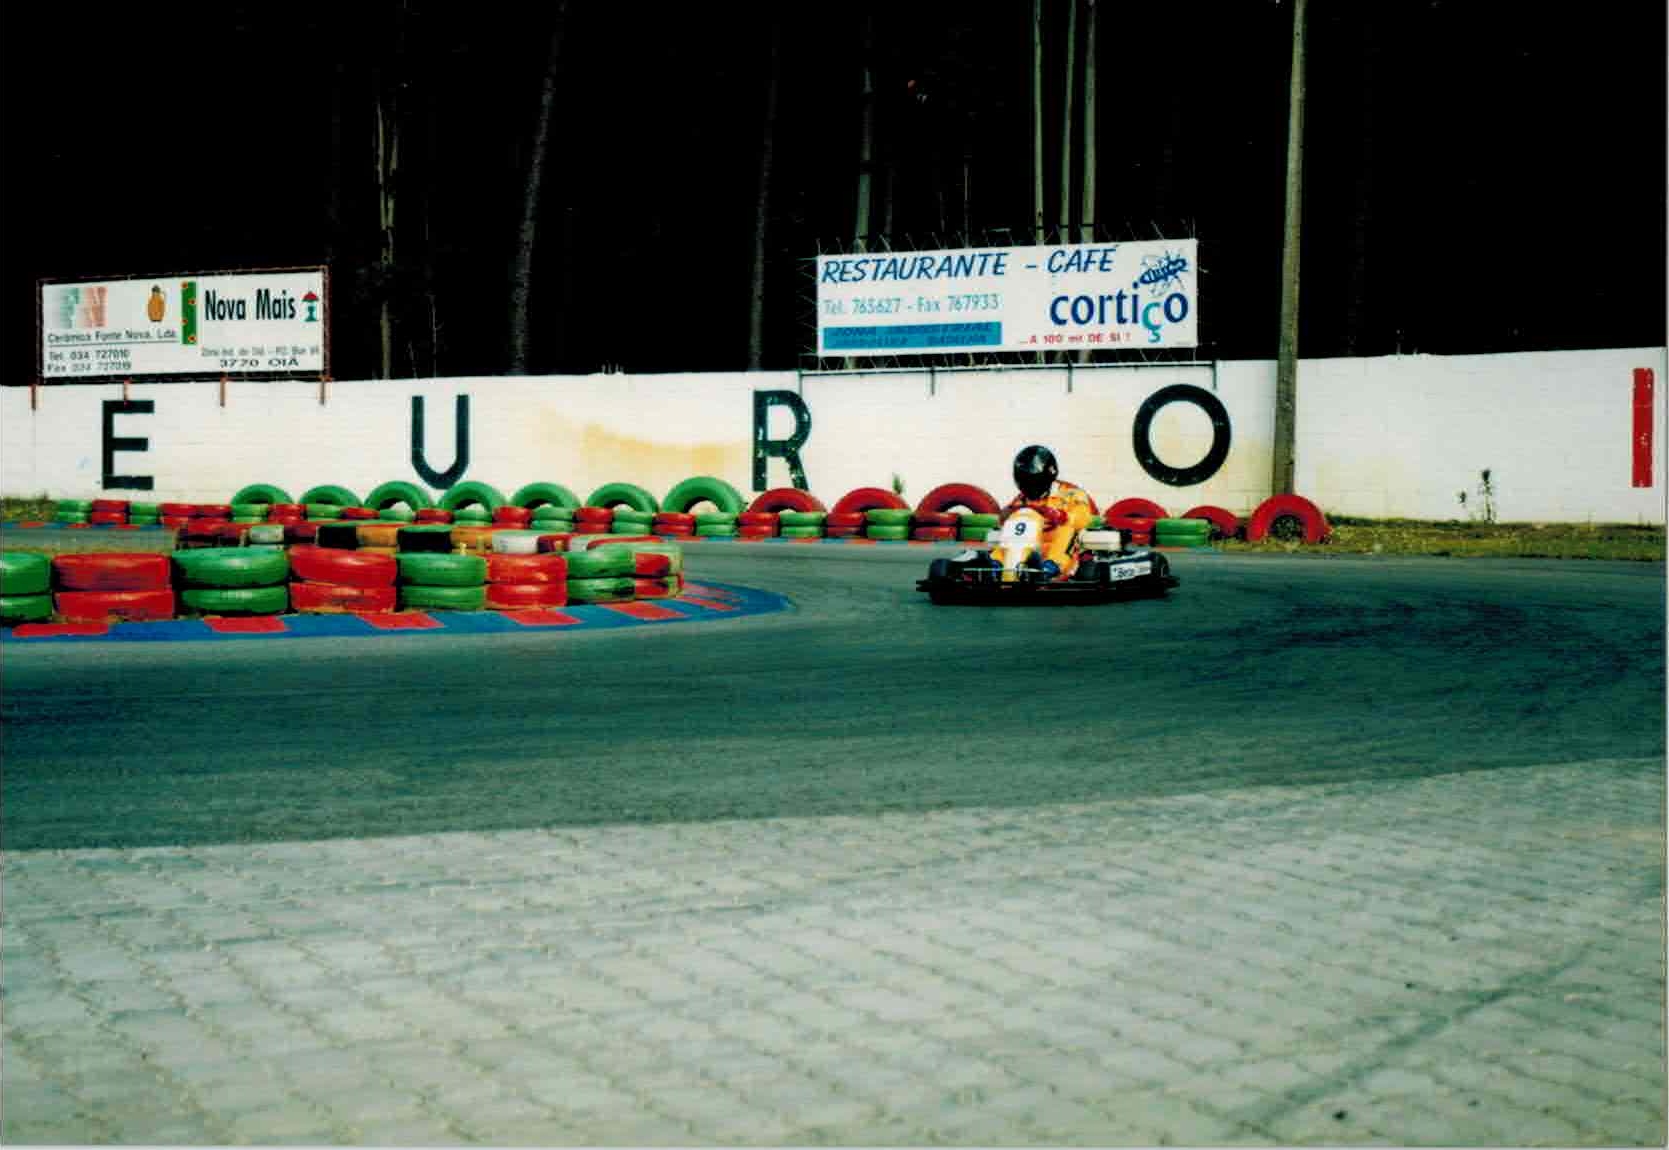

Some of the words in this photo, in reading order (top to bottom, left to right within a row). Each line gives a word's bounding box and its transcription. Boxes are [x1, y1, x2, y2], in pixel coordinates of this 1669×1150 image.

[822, 253, 1010, 283] RESTAURANTE
[205, 289, 246, 320] Nova
[256, 288, 296, 320] Mais
[917, 297, 940, 312] Fax
[947, 294, 999, 312] 767933
[1050, 281, 1189, 343] cortiço
[1088, 333, 1101, 343] DE
[1014, 521, 1027, 537] 9
